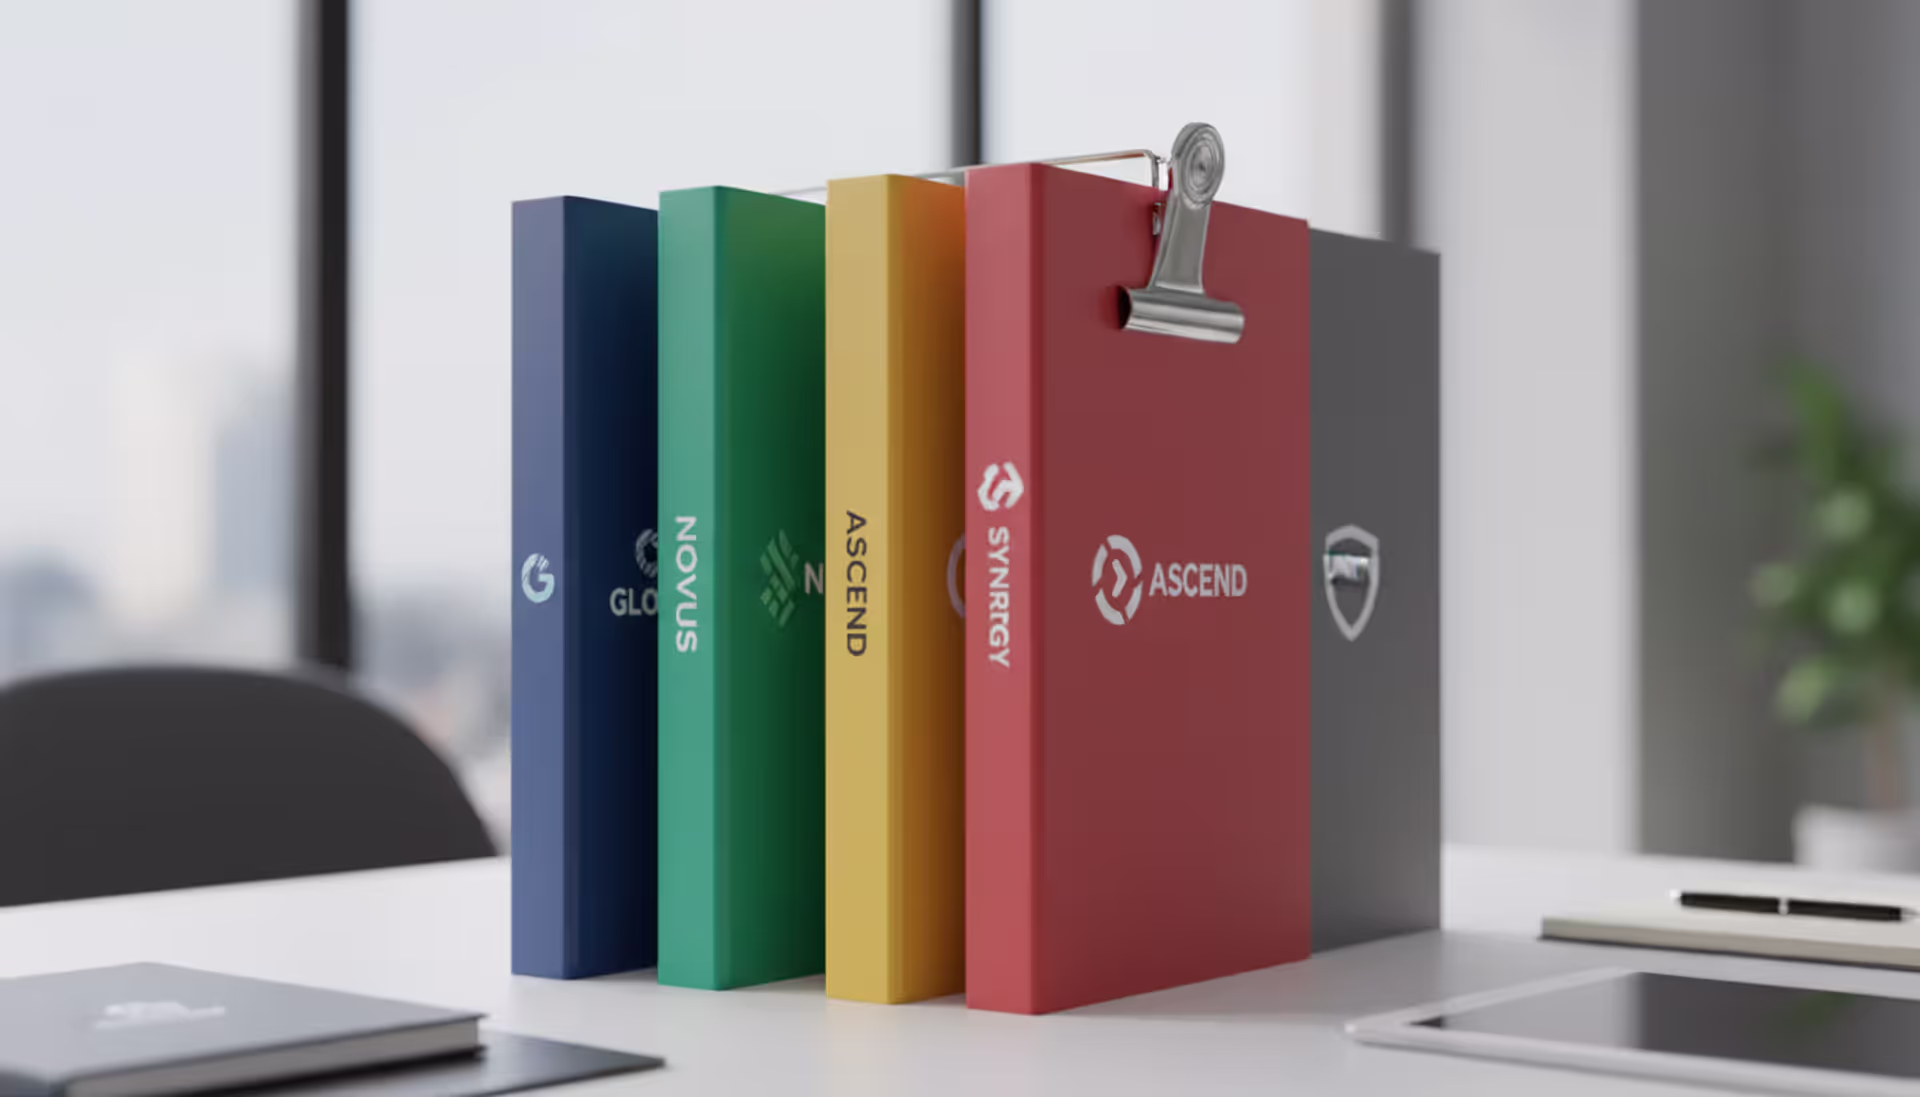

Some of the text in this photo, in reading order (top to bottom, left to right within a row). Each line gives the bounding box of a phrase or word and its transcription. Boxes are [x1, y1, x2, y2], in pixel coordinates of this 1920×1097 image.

[675, 515, 698, 653] NOVUS
[846, 510, 867, 656] ASCEND
[1149, 562, 1248, 597] ASCEND
